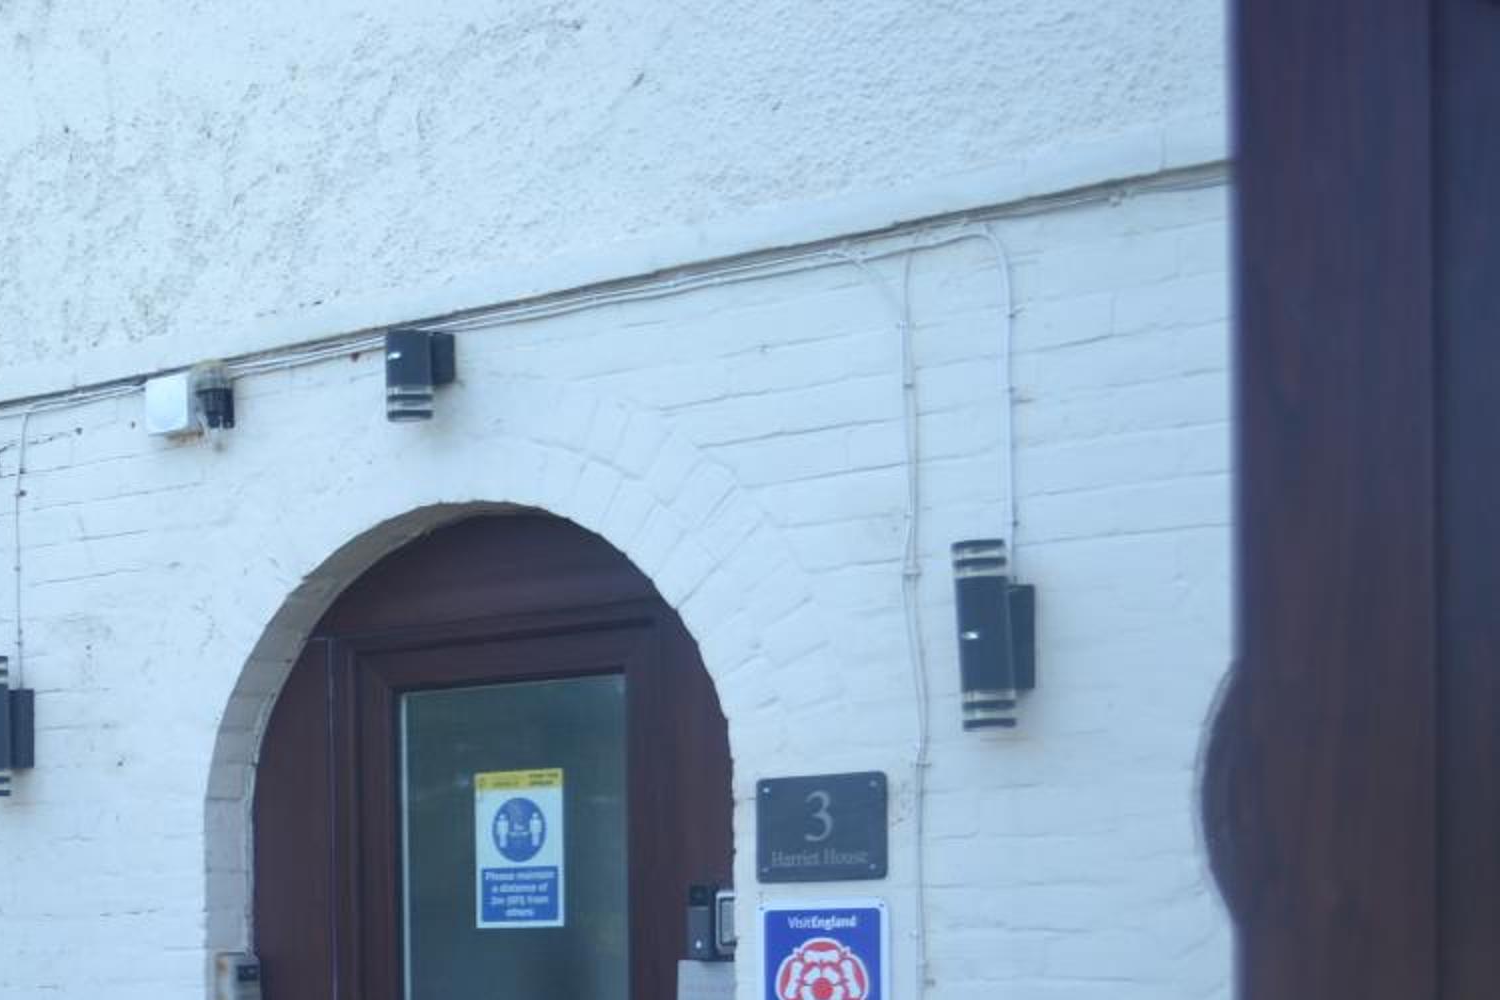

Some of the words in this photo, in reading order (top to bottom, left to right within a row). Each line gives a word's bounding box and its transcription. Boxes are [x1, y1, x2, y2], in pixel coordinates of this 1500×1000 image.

[804, 789, 833, 842] 3
[771, 849, 819, 868] Harriet
[823, 848, 869, 865] House
[787, 915, 857, 931] VisitEngland
